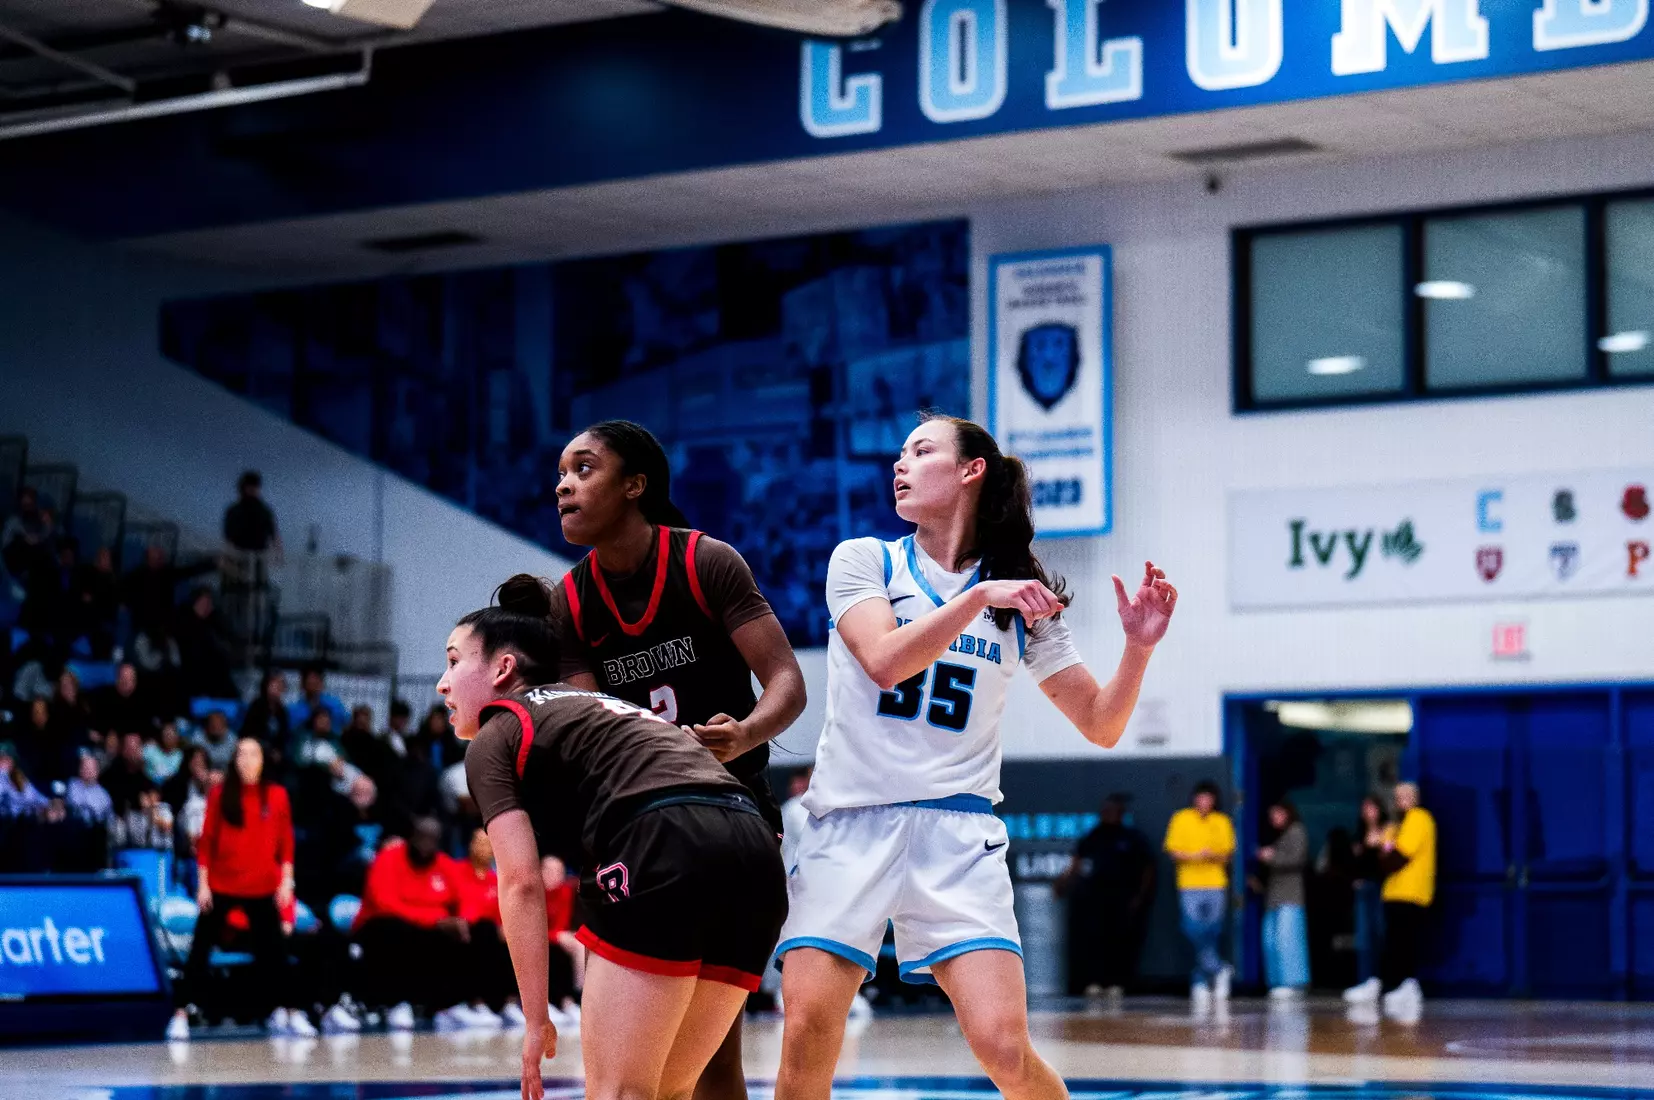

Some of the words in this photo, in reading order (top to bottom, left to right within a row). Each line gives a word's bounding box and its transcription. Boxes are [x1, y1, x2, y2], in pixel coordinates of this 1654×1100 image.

[1288, 518, 1374, 582] Ivy
[603, 636, 696, 685] BROWN
[877, 660, 977, 733] 35
[0, 916, 105, 964] arter
